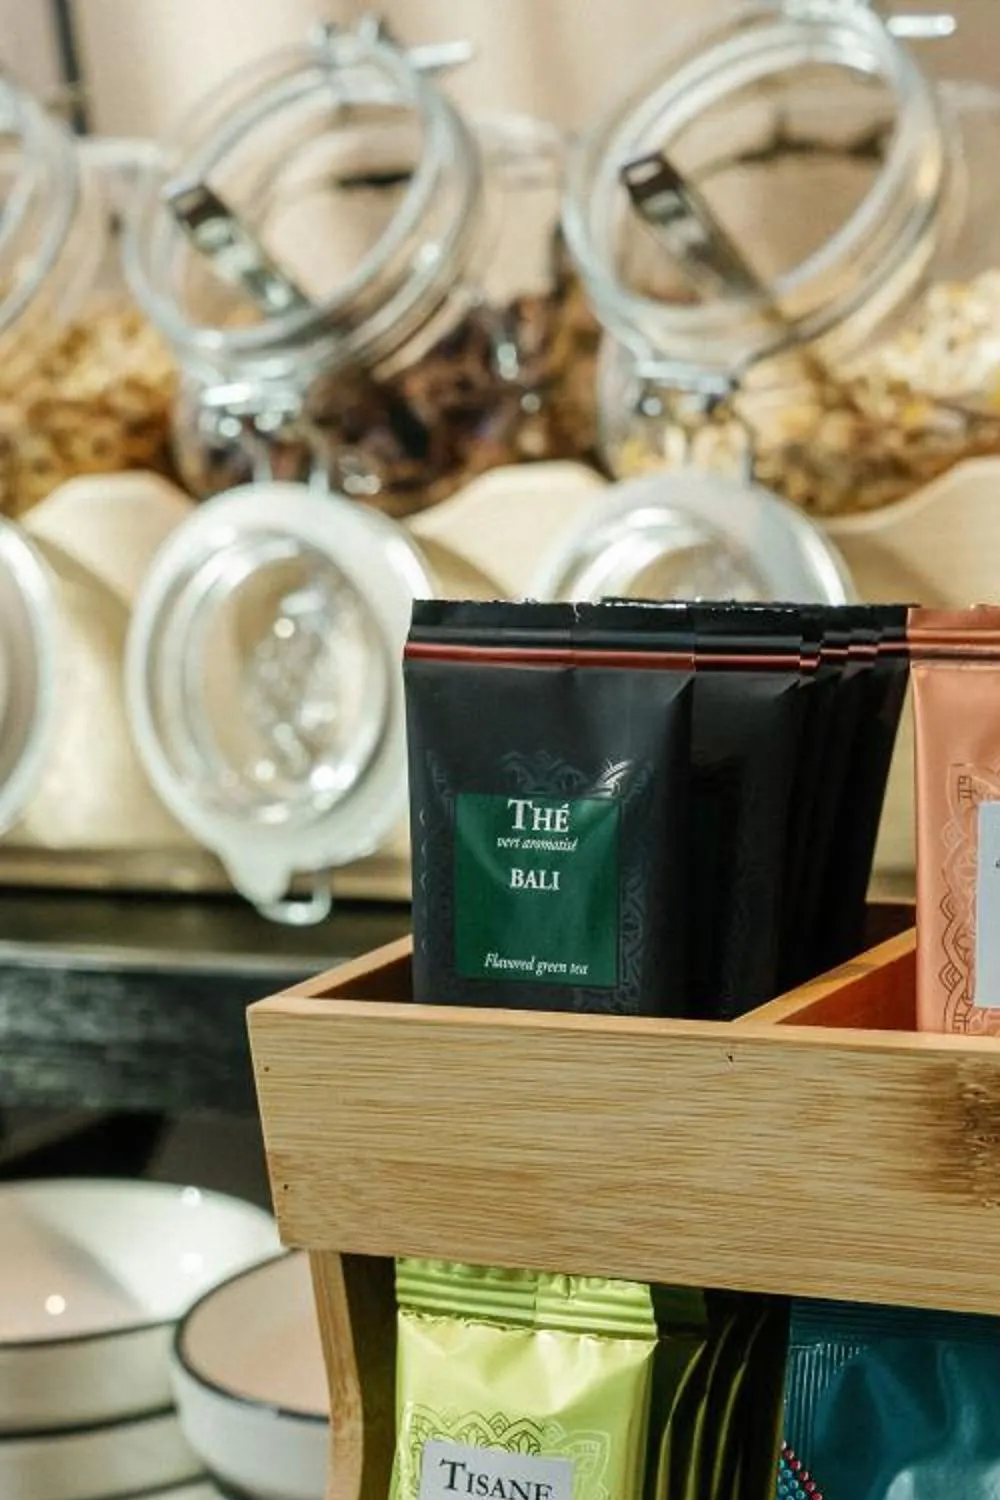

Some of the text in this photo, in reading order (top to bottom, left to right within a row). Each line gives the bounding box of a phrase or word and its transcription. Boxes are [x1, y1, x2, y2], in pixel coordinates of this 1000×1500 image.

[497, 836, 519, 848] vert
[510, 868, 560, 891] BALI
[484, 953, 589, 976] Flavored green tea
